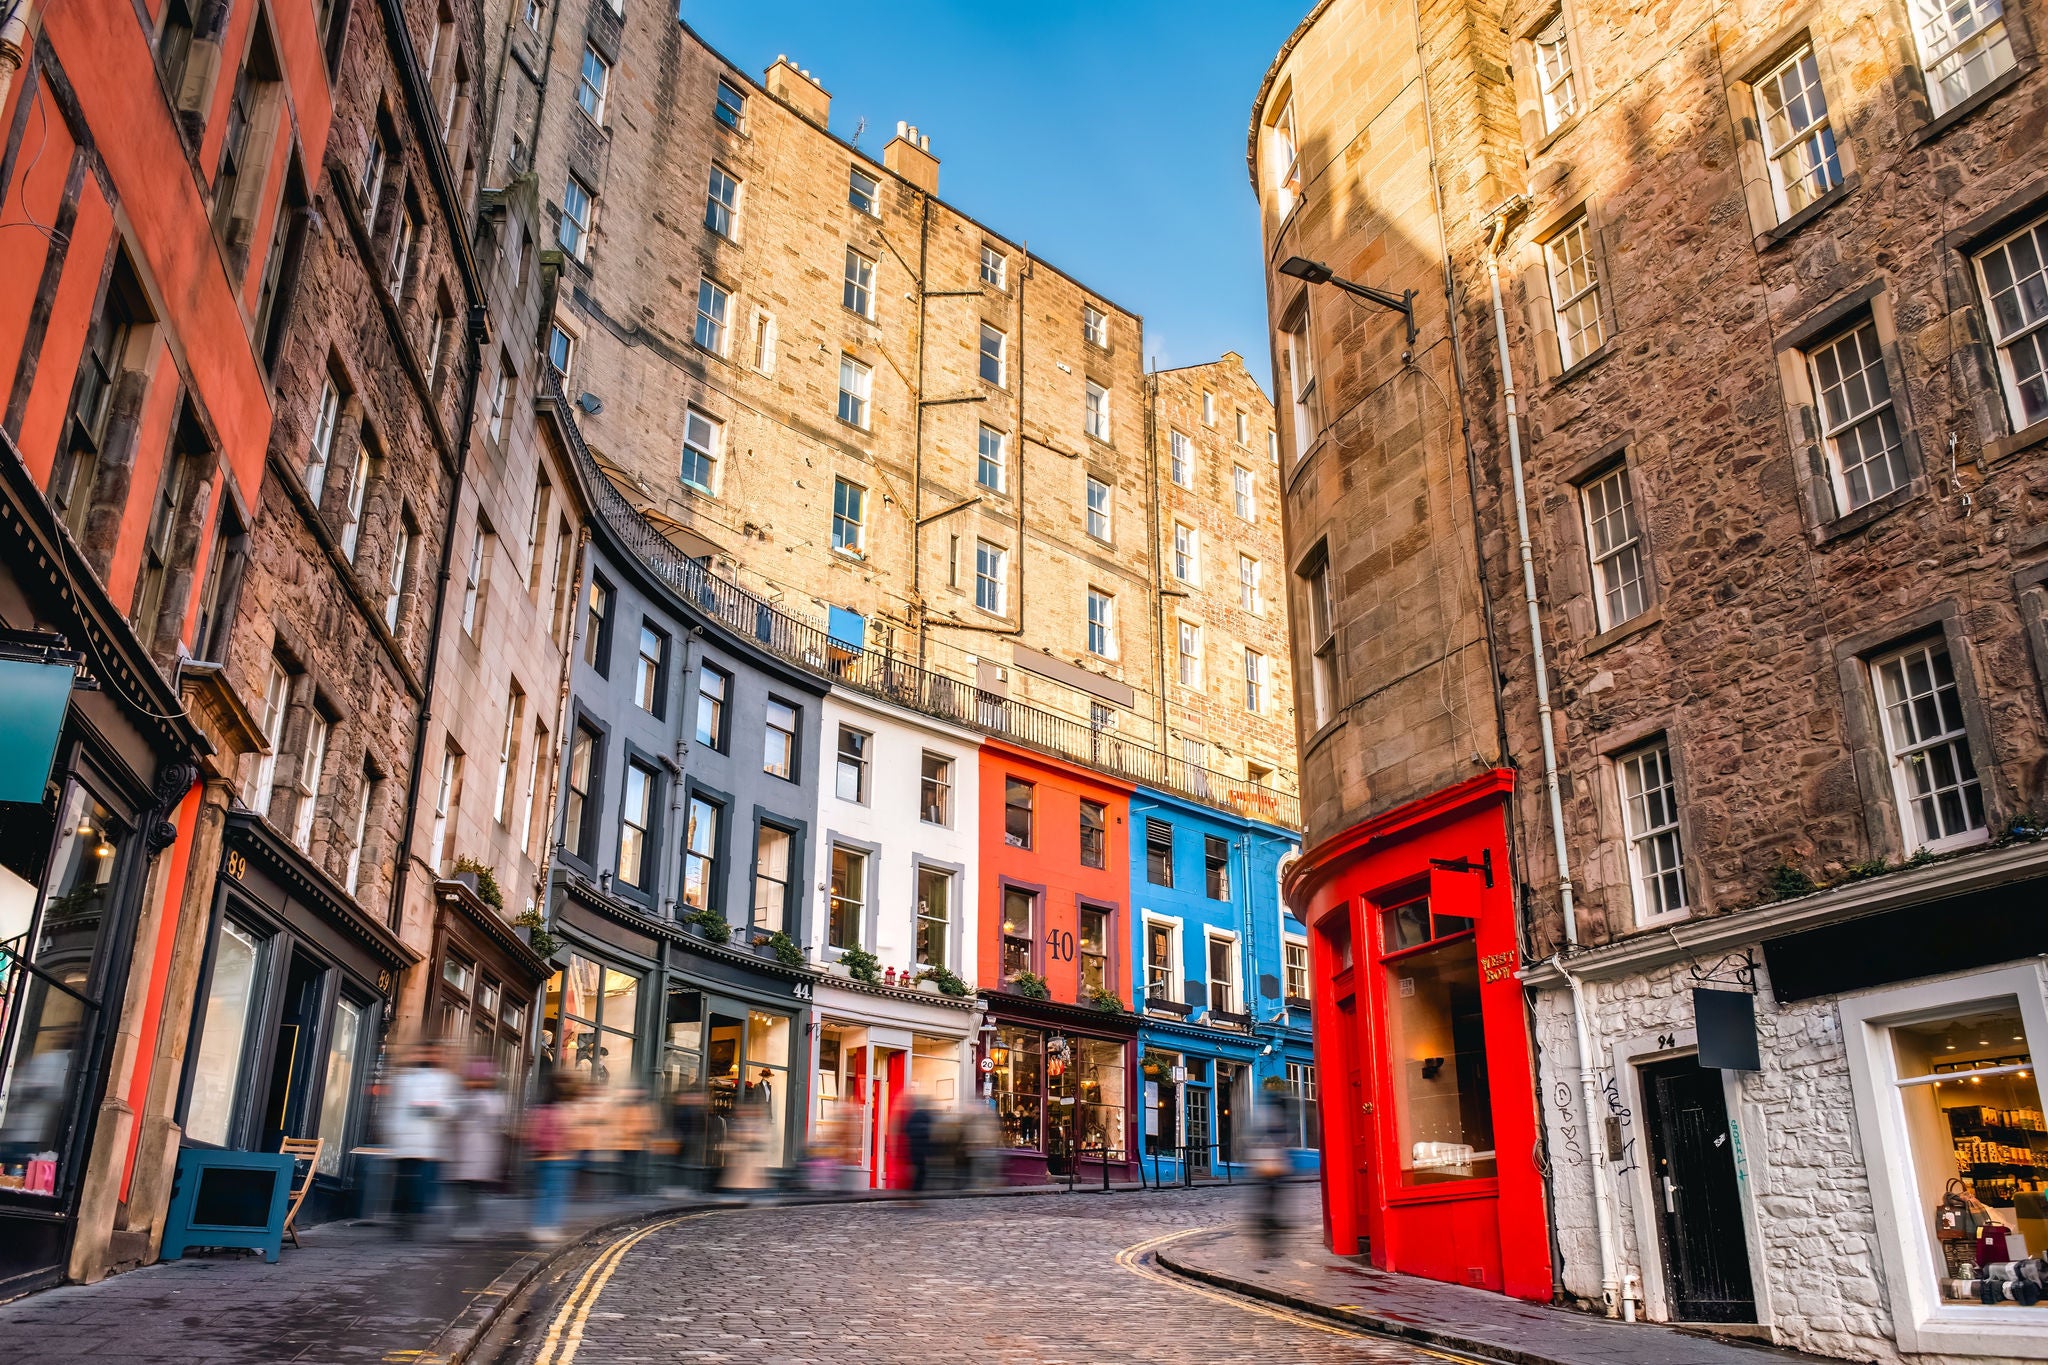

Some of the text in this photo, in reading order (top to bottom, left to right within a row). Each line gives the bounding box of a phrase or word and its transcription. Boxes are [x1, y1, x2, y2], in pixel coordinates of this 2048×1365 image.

[228, 850, 246, 880] 89
[1045, 929, 1074, 962] 40
[1480, 950, 1514, 971] WEST
[378, 969, 390, 991] 89
[1485, 965, 1511, 984] BOW
[1657, 1032, 1676, 1049] 94
[982, 1060, 993, 1069] 20
